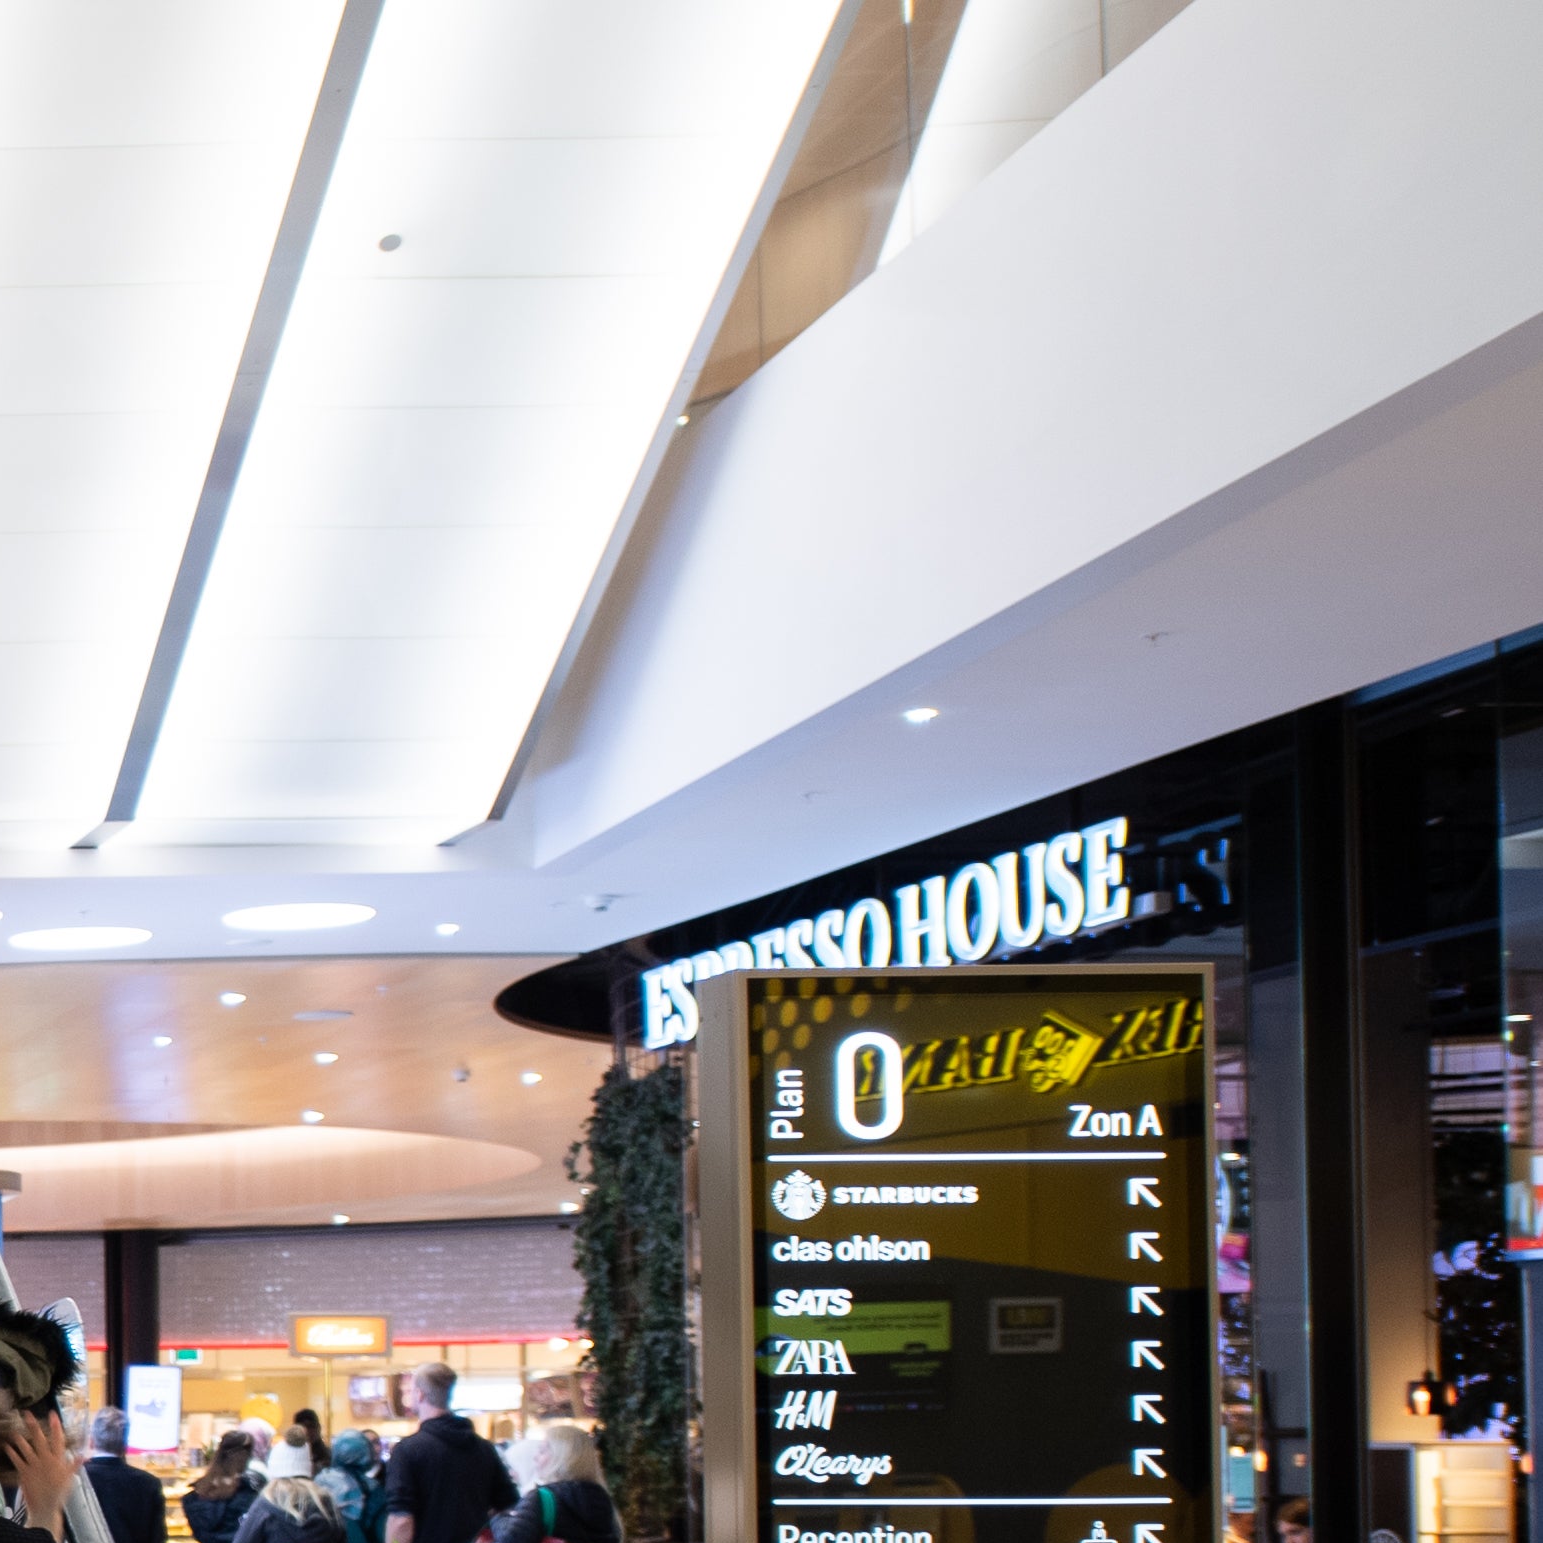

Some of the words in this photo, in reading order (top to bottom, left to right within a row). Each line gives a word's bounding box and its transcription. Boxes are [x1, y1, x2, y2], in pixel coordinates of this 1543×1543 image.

[896, 816, 1130, 967] HOUSE
[770, 1068, 803, 1139] Plan
[835, 1031, 905, 1140] 0
[1068, 1105, 1130, 1137] Zon
[1136, 1104, 1163, 1137] A
[832, 1185, 979, 1205] STARBUCKS
[772, 1235, 833, 1262] clas
[835, 1234, 931, 1262] ohlson
[773, 1288, 853, 1317] SATS
[774, 1339, 856, 1375] ZARA
[775, 1389, 837, 1431] H&M
